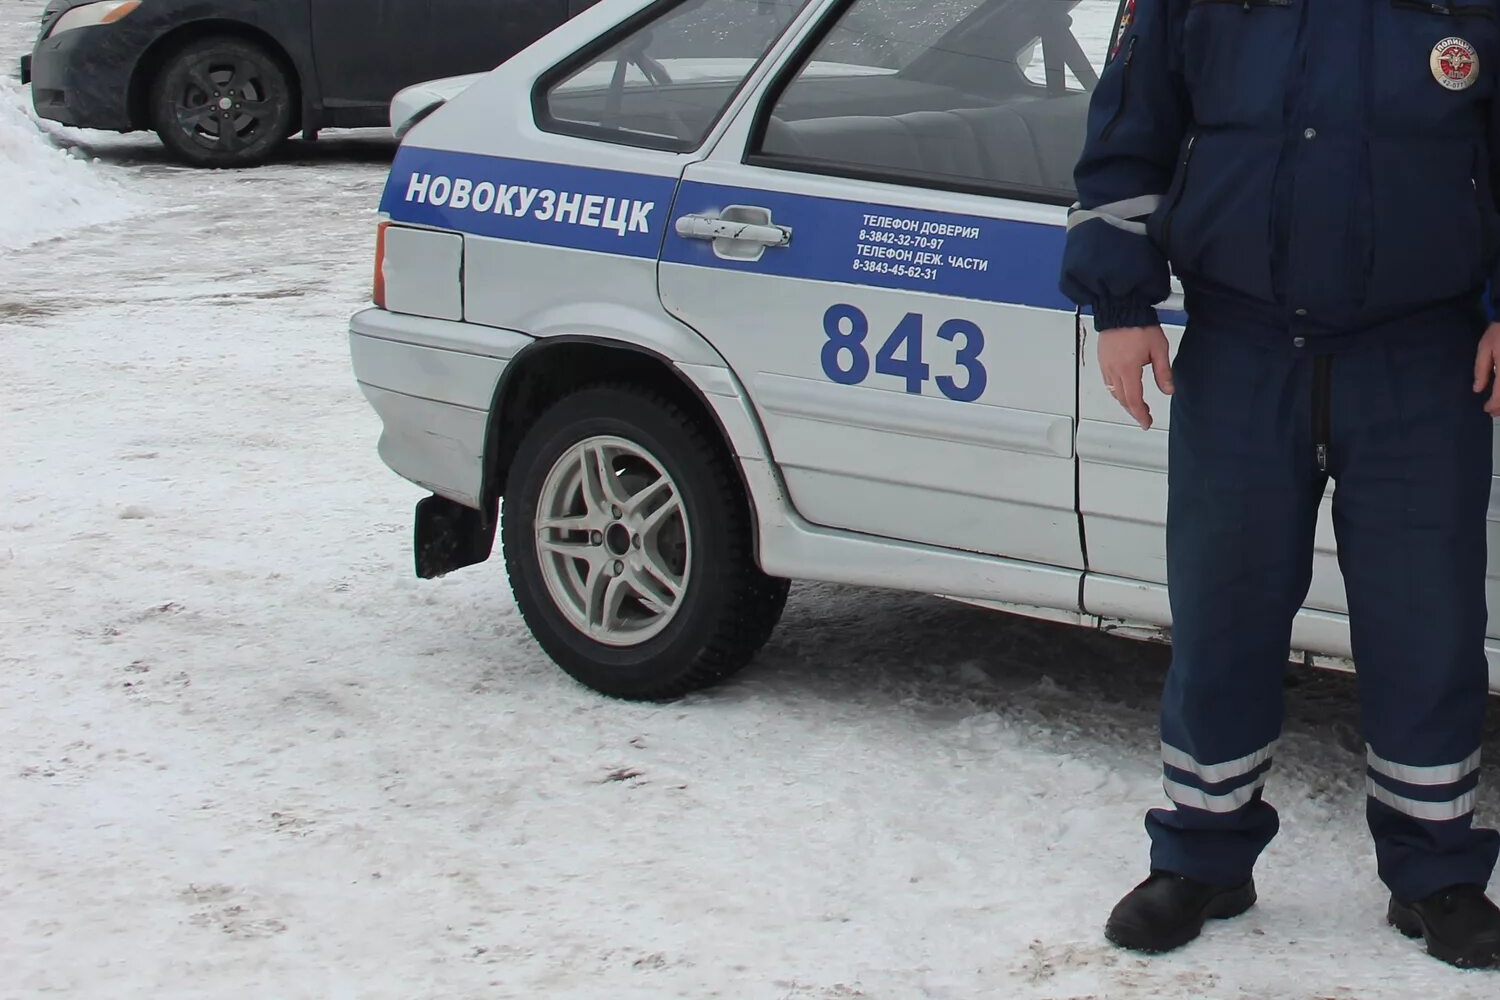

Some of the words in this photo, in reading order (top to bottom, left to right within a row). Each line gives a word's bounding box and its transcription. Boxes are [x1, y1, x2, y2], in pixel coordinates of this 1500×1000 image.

[405, 172, 655, 237] НОВОКУЗНЕЦК
[859, 229, 944, 250] 8-3842-32-70-97
[863, 214, 919, 232] ТЕЛЕФОН
[920, 221, 979, 239] ДОВЕРИЯ
[853, 259, 937, 280] 8-3843-45-62-31
[857, 244, 912, 262] ТЕЛЕФОН
[914, 251, 944, 266] ДЕЖ.
[948, 255, 988, 271] ЧАСТИ
[820, 303, 988, 403] 843
